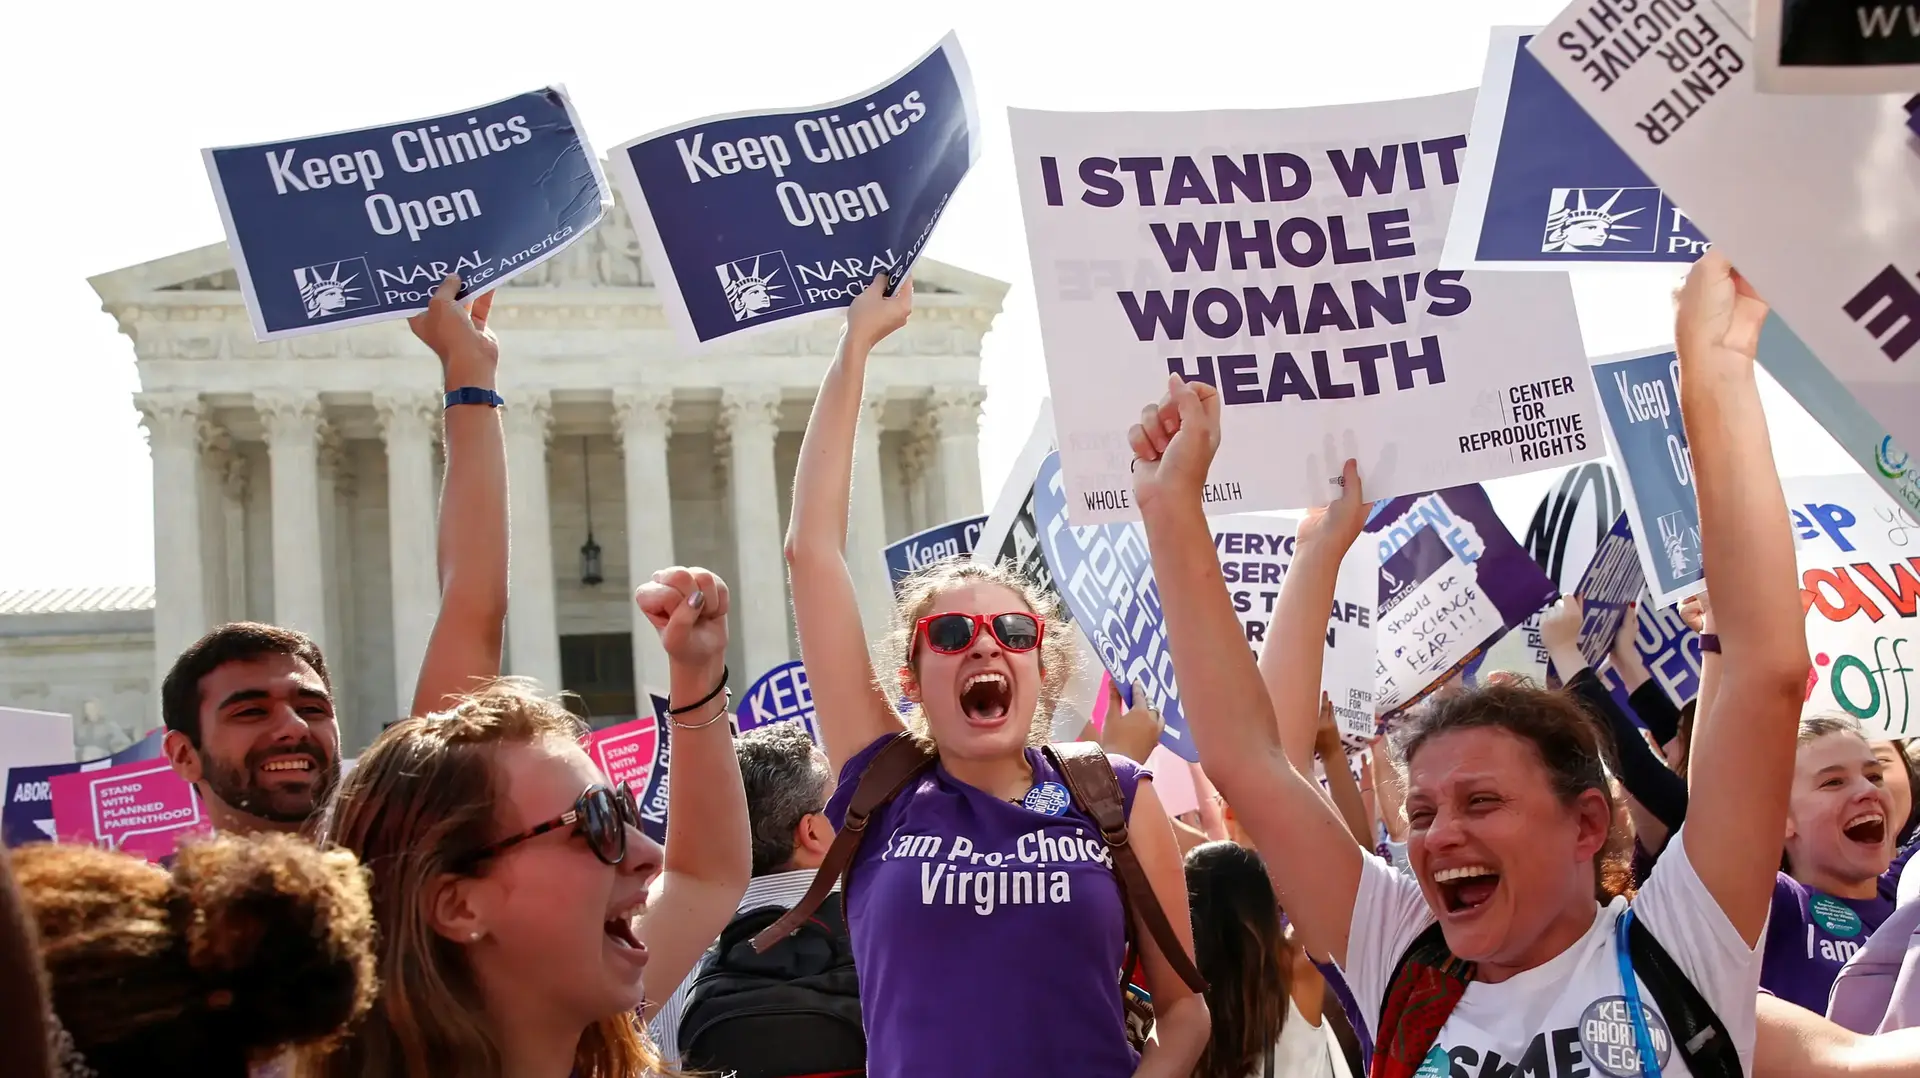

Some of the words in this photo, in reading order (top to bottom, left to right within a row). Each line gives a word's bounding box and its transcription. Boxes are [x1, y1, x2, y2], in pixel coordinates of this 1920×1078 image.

[1558, 0, 1638, 62] GHTS
[1582, 0, 1697, 92] DUCTIVE
[1655, 14, 1720, 72] FOR
[1634, 43, 1745, 145] CENTER
[265, 148, 385, 195] Keep
[391, 114, 532, 173] Clinics
[676, 132, 792, 184] Keep
[794, 90, 926, 165] Clinics
[1040, 156, 1064, 206] I
[1078, 152, 1312, 208] STAND
[1327, 134, 1469, 198] WIT
[364, 187, 482, 242] Open
[776, 180, 890, 236] Open
[805, 264, 904, 304] Pro-Chce
[905, 193, 948, 265] America
[1150, 208, 1416, 273] WHOLE
[376, 250, 492, 287] NARAL
[384, 267, 494, 305] Pro-Coice
[497, 224, 573, 272] America
[795, 249, 902, 285] NARAL
[1116, 269, 1472, 342] WOMAN'S
[1166, 335, 1446, 406] HEALTH
[1508, 376, 1575, 404] CENTER
[1614, 370, 1671, 429] Keep
[1513, 402, 1546, 423] FOR
[1459, 414, 1583, 454] REPRODUCTIVE
[1521, 433, 1587, 462] RIGHTS
[1084, 490, 1130, 511] WHOLE
[1201, 483, 1243, 504] EALTH
[1214, 532, 1298, 558] VERYO
[1379, 497, 1452, 563] RDEN
[1791, 503, 1857, 552] ep
[1800, 557, 1920, 624] aw
[1330, 600, 1371, 628] AFE
[1388, 594, 1431, 634] should
[1411, 587, 1475, 641] SCIENCE
[749, 666, 814, 724] KEE
[1348, 699, 1361, 710] FOR
[1349, 688, 1372, 702] CENTER
[1332, 705, 1372, 724] EPRODUCTIVE
[1348, 720, 1371, 734] RIGHTS
[607, 743, 640, 760] STAND
[611, 756, 637, 770] WITH
[100, 783, 142, 797] STAND
[615, 763, 651, 782] PLANN
[14, 781, 53, 802] ABOR
[102, 795, 135, 808] WITH
[103, 802, 164, 818] PLANNED
[1034, 784, 1056, 813] BORTION
[104, 807, 192, 830] PARENTHOOD
[894, 833, 943, 860] am
[921, 862, 1071, 915] Virginia
[1807, 923, 1815, 960] I
[1819, 940, 1859, 963] am
[1586, 1019, 1668, 1052] ABORTN
[1594, 1043, 1661, 1073] LEGA
